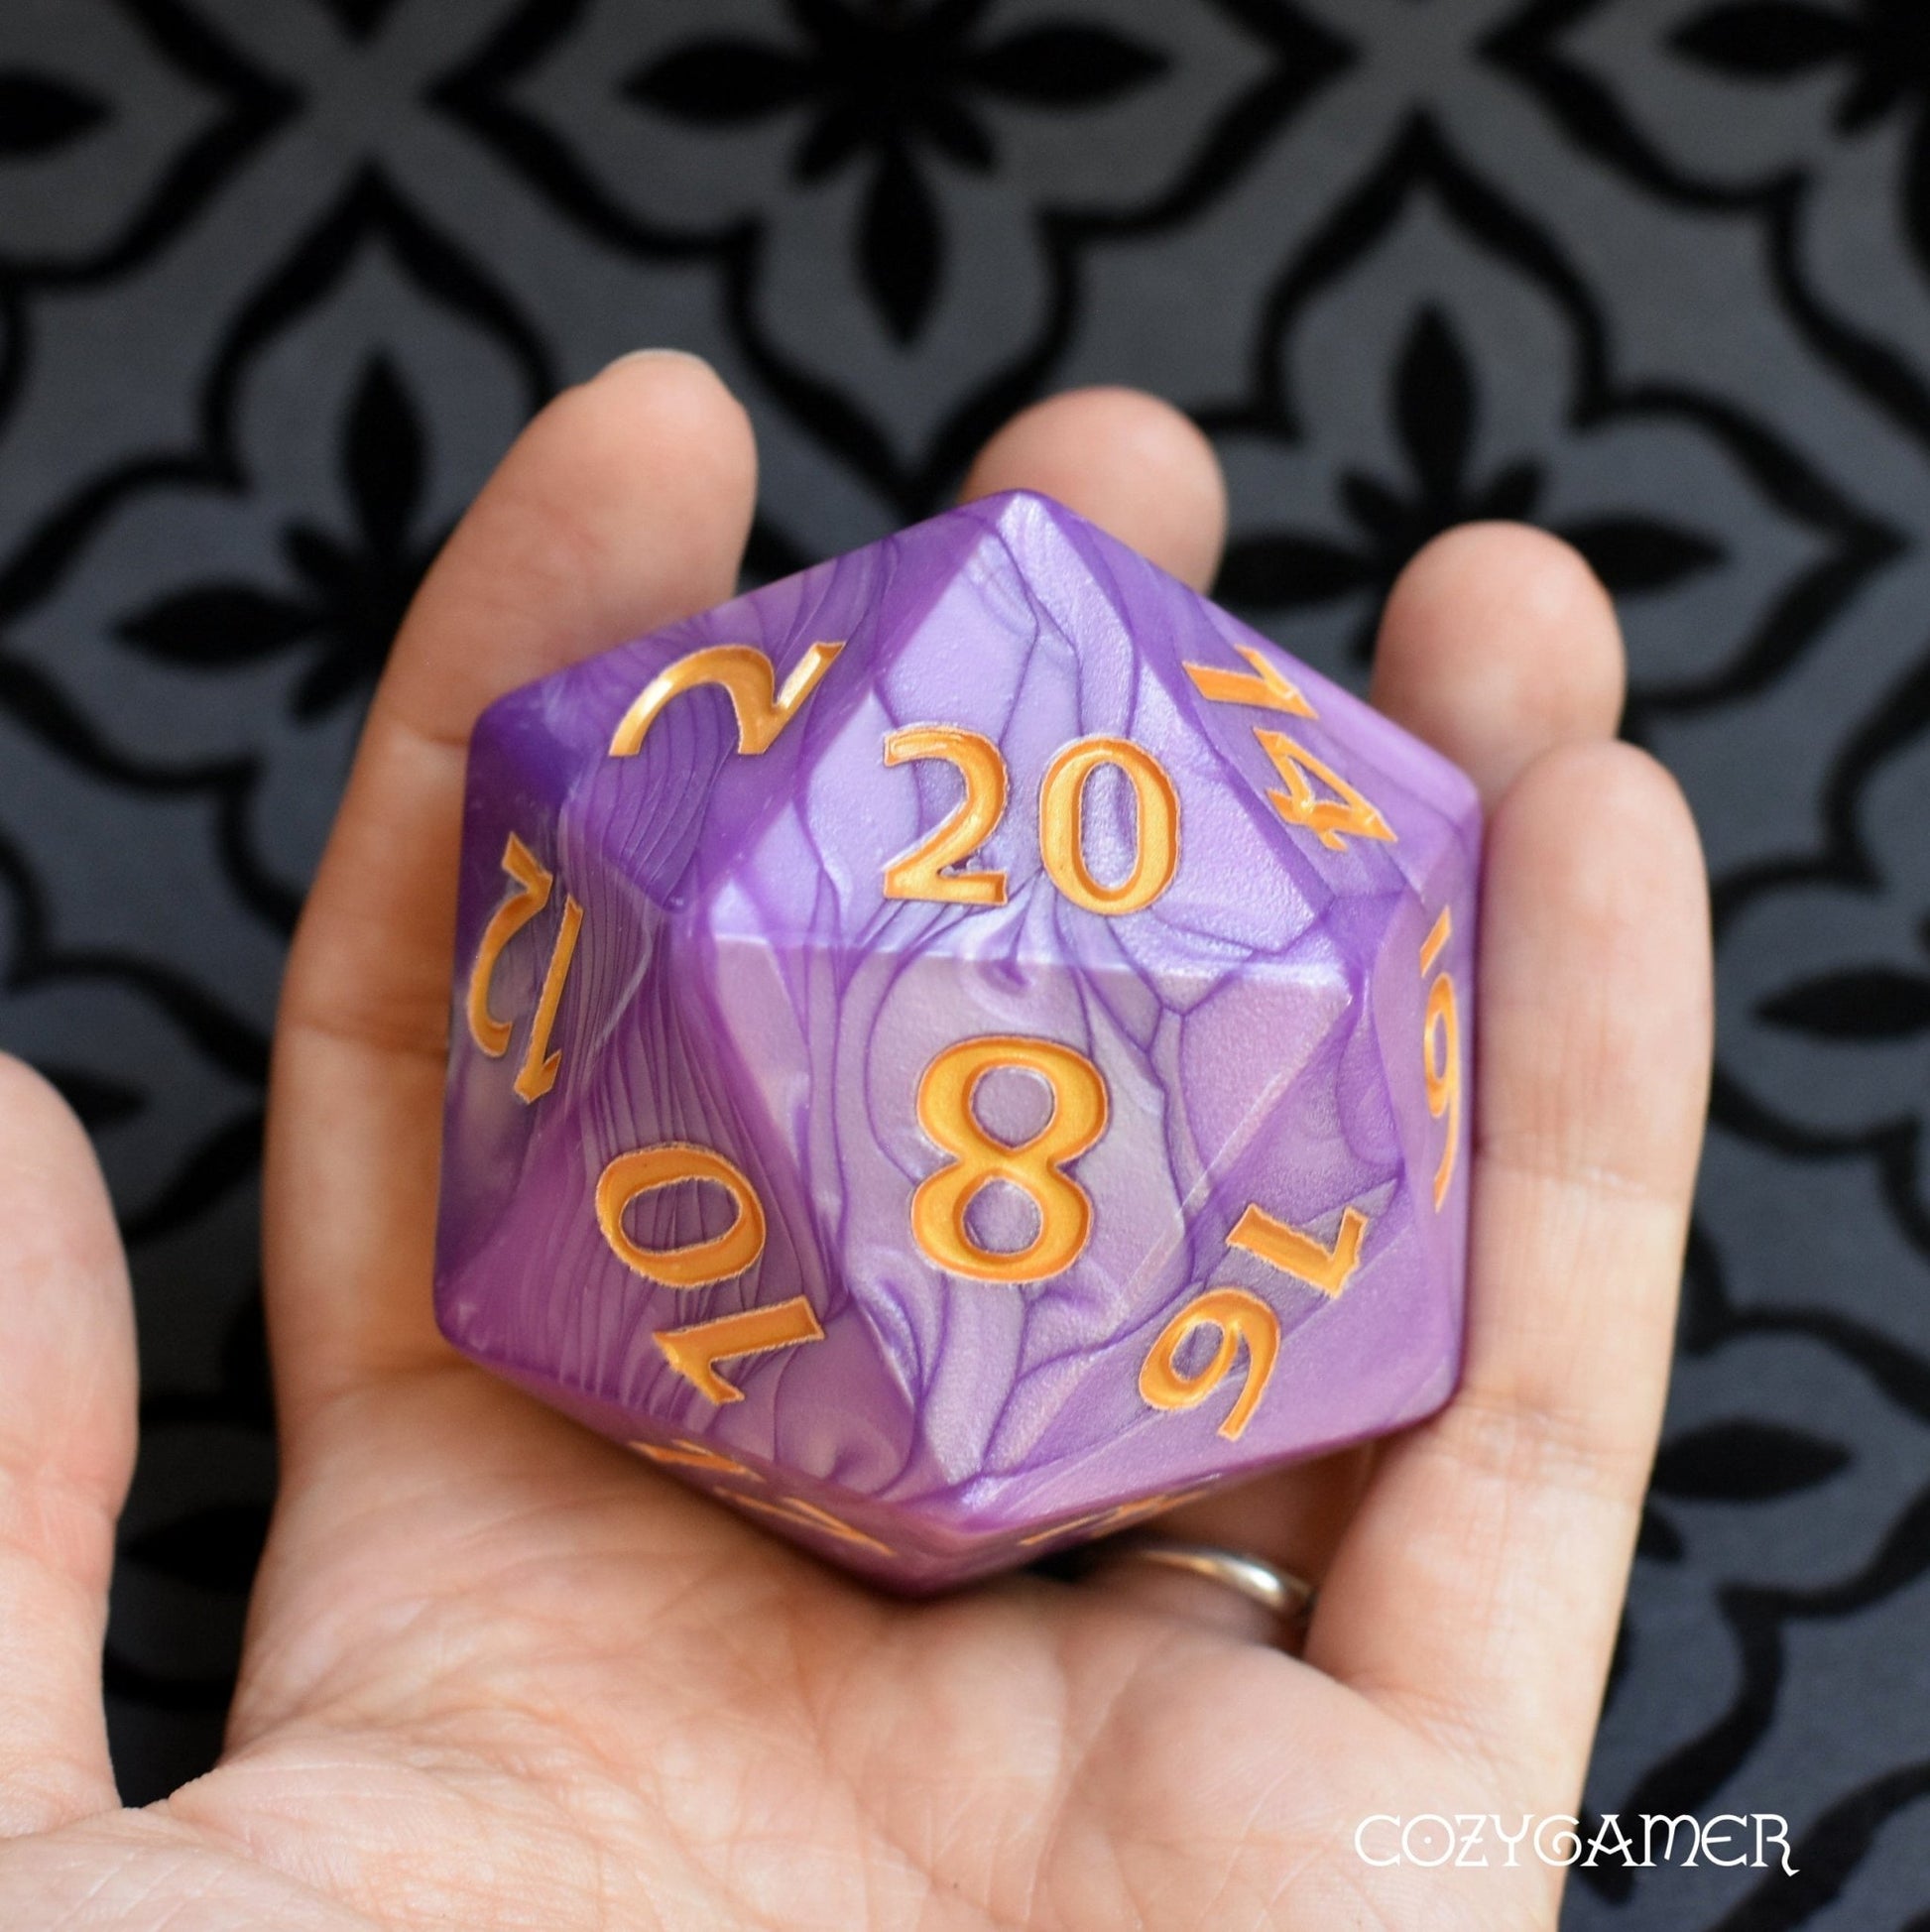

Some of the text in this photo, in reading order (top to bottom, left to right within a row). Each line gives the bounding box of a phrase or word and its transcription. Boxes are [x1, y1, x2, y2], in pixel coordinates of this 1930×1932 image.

[608, 641, 845, 758] 2
[1183, 645, 1398, 851] 14
[883, 726, 1179, 914] 20
[467, 832, 585, 1103] 12
[595, 1141, 826, 1406] 10
[911, 1035, 1110, 1284] 8
[1140, 1204, 1367, 1440] 16
